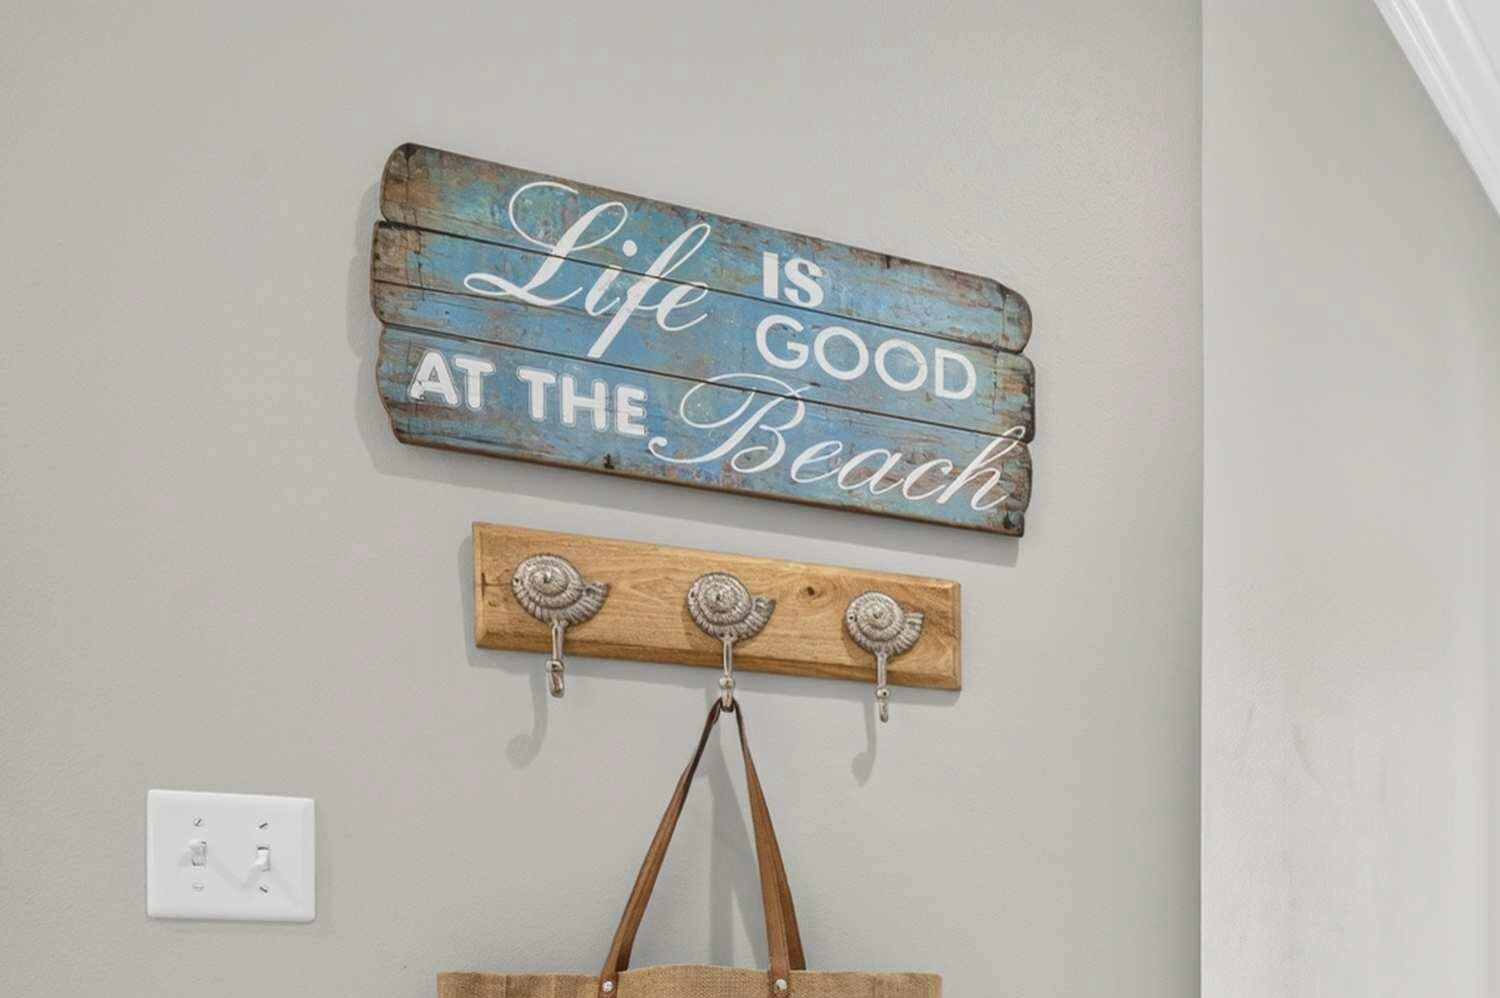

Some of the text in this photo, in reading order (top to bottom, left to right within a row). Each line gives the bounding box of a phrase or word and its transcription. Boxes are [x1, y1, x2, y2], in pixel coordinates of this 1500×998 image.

[462, 180, 824, 358] Life IS
[408, 351, 1027, 512] AT THE Beach
[755, 313, 977, 400] GOOD
